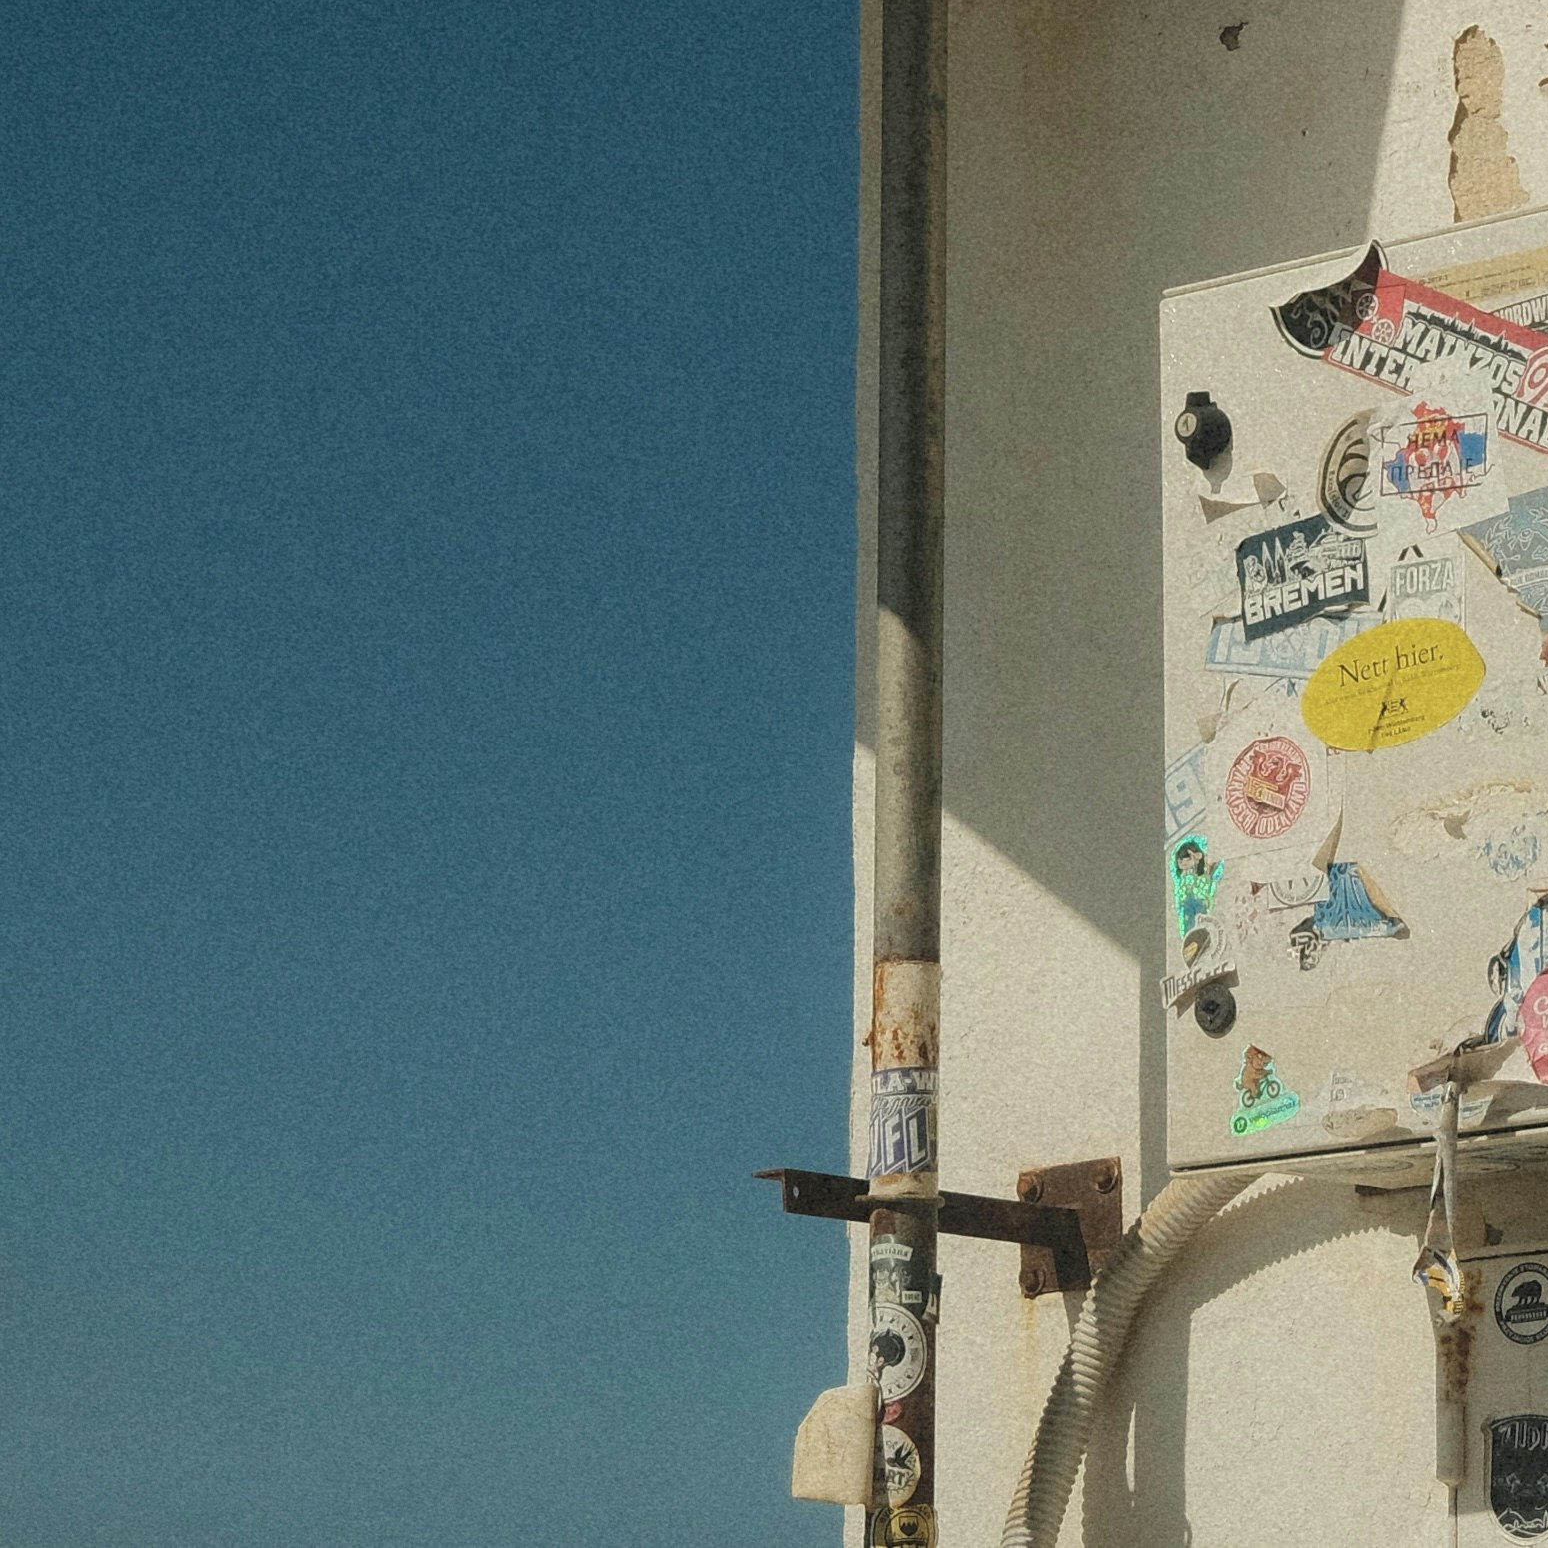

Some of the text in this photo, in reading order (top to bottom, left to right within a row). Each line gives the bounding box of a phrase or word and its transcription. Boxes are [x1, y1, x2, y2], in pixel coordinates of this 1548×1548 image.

[1406, 429, 1460, 449] НЕМА
[1245, 563, 1366, 626] BREMEN
[1396, 560, 1455, 596] FORZA
[1337, 656, 1390, 687] Nett
[1394, 643, 1445, 671] hier.
